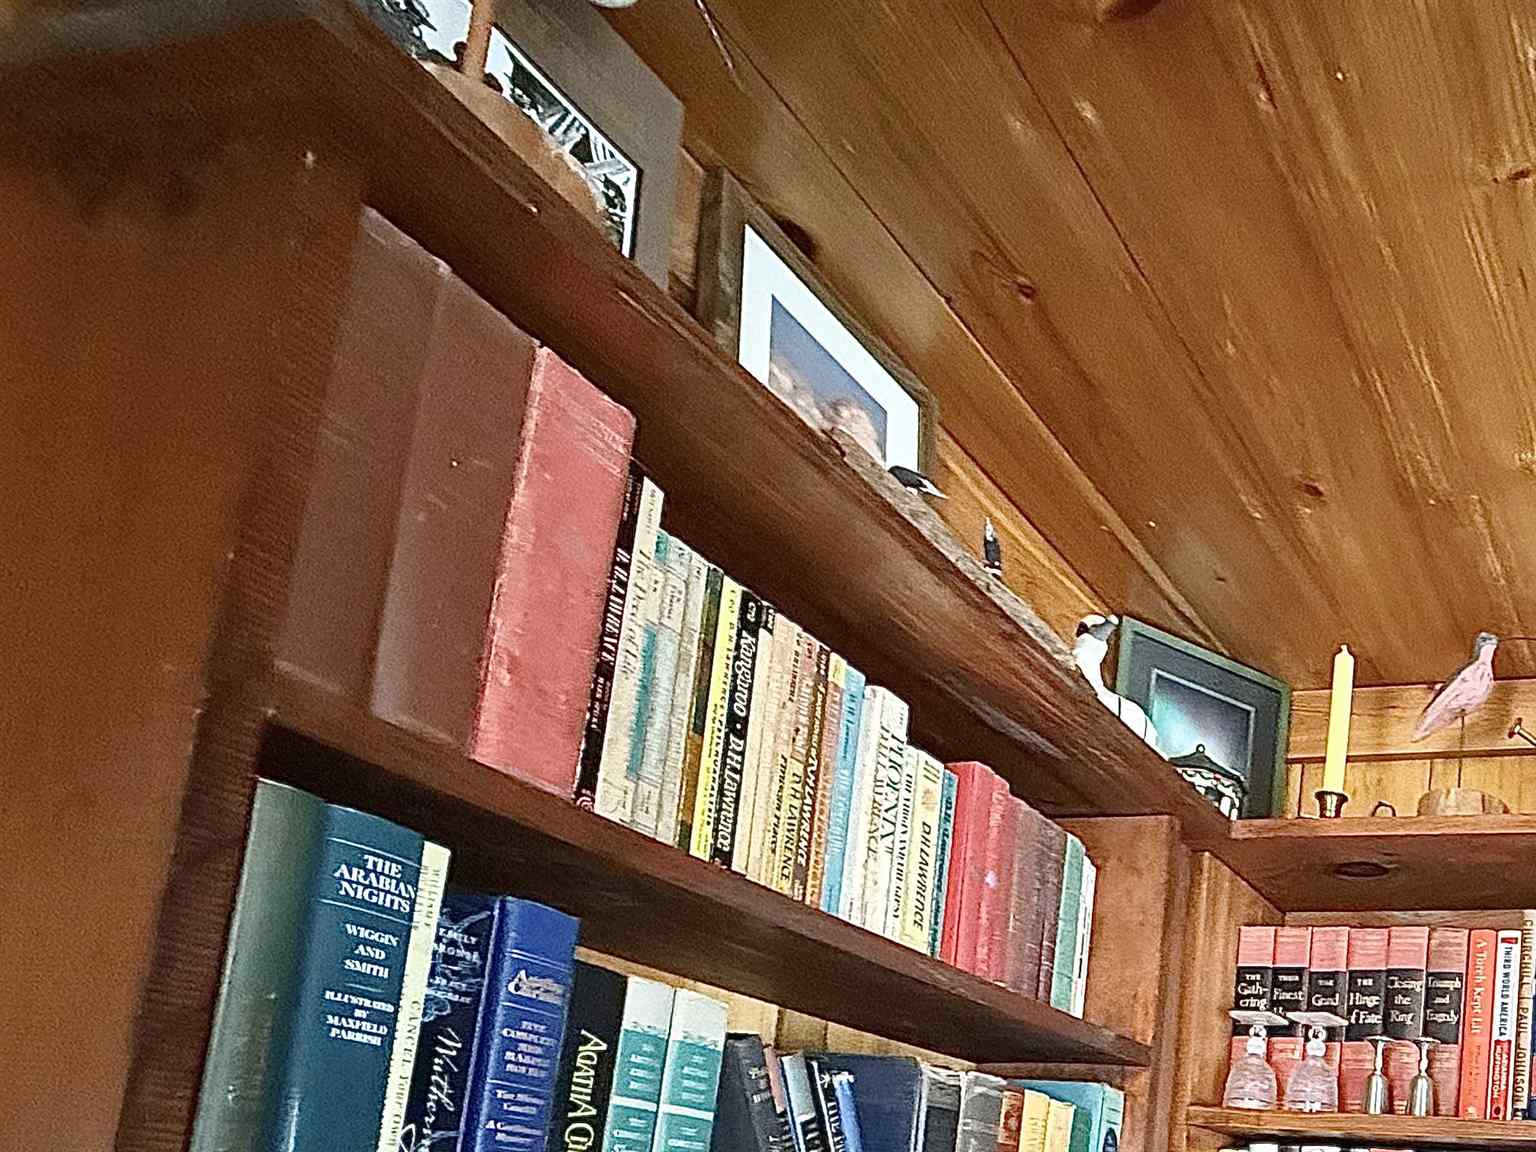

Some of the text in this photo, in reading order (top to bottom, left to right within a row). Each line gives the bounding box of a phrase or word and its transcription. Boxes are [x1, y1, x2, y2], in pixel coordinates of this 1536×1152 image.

[731, 628, 757, 718] Kangaroo
[364, 854, 402, 878] THE
[333, 864, 417, 899] ARABIAN
[340, 882, 411, 914] NIGHTS
[345, 923, 400, 947] WIGGIN
[1477, 938, 1488, 948] A
[354, 944, 386, 960] AND
[344, 959, 389, 979] SMITH
[1498, 945, 1513, 1037] THIRD WORLD AMERICA
[1389, 1011, 1414, 1026] Ring
[1515, 919, 1535, 1104] CHURCHILL PAUL JOHNSON
[326, 1015, 388, 1035] MAXFIELD
[329, 1028, 383, 1046] PARRISH
[567, 1029, 608, 1118] AGATHA
